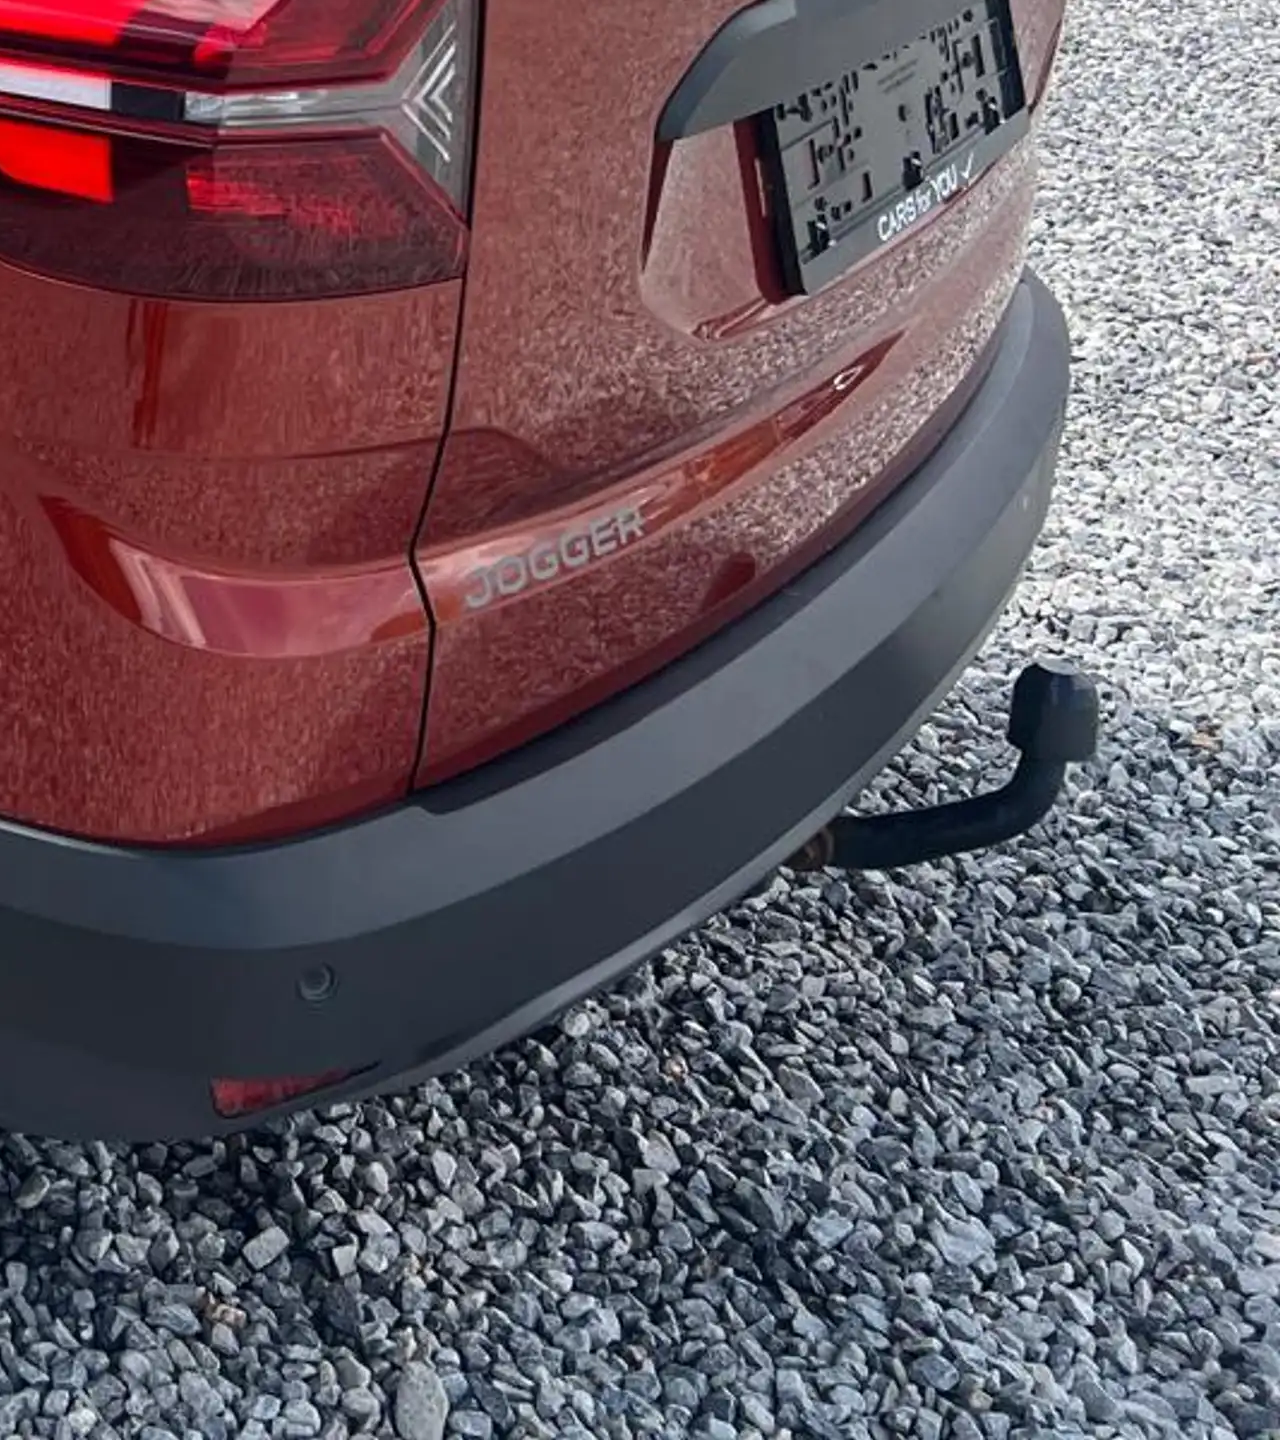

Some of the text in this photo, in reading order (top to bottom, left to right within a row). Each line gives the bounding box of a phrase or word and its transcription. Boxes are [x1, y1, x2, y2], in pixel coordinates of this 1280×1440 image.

[877, 193, 916, 242] CARS
[929, 163, 959, 203] YOU
[464, 504, 647, 610] JOGGER
